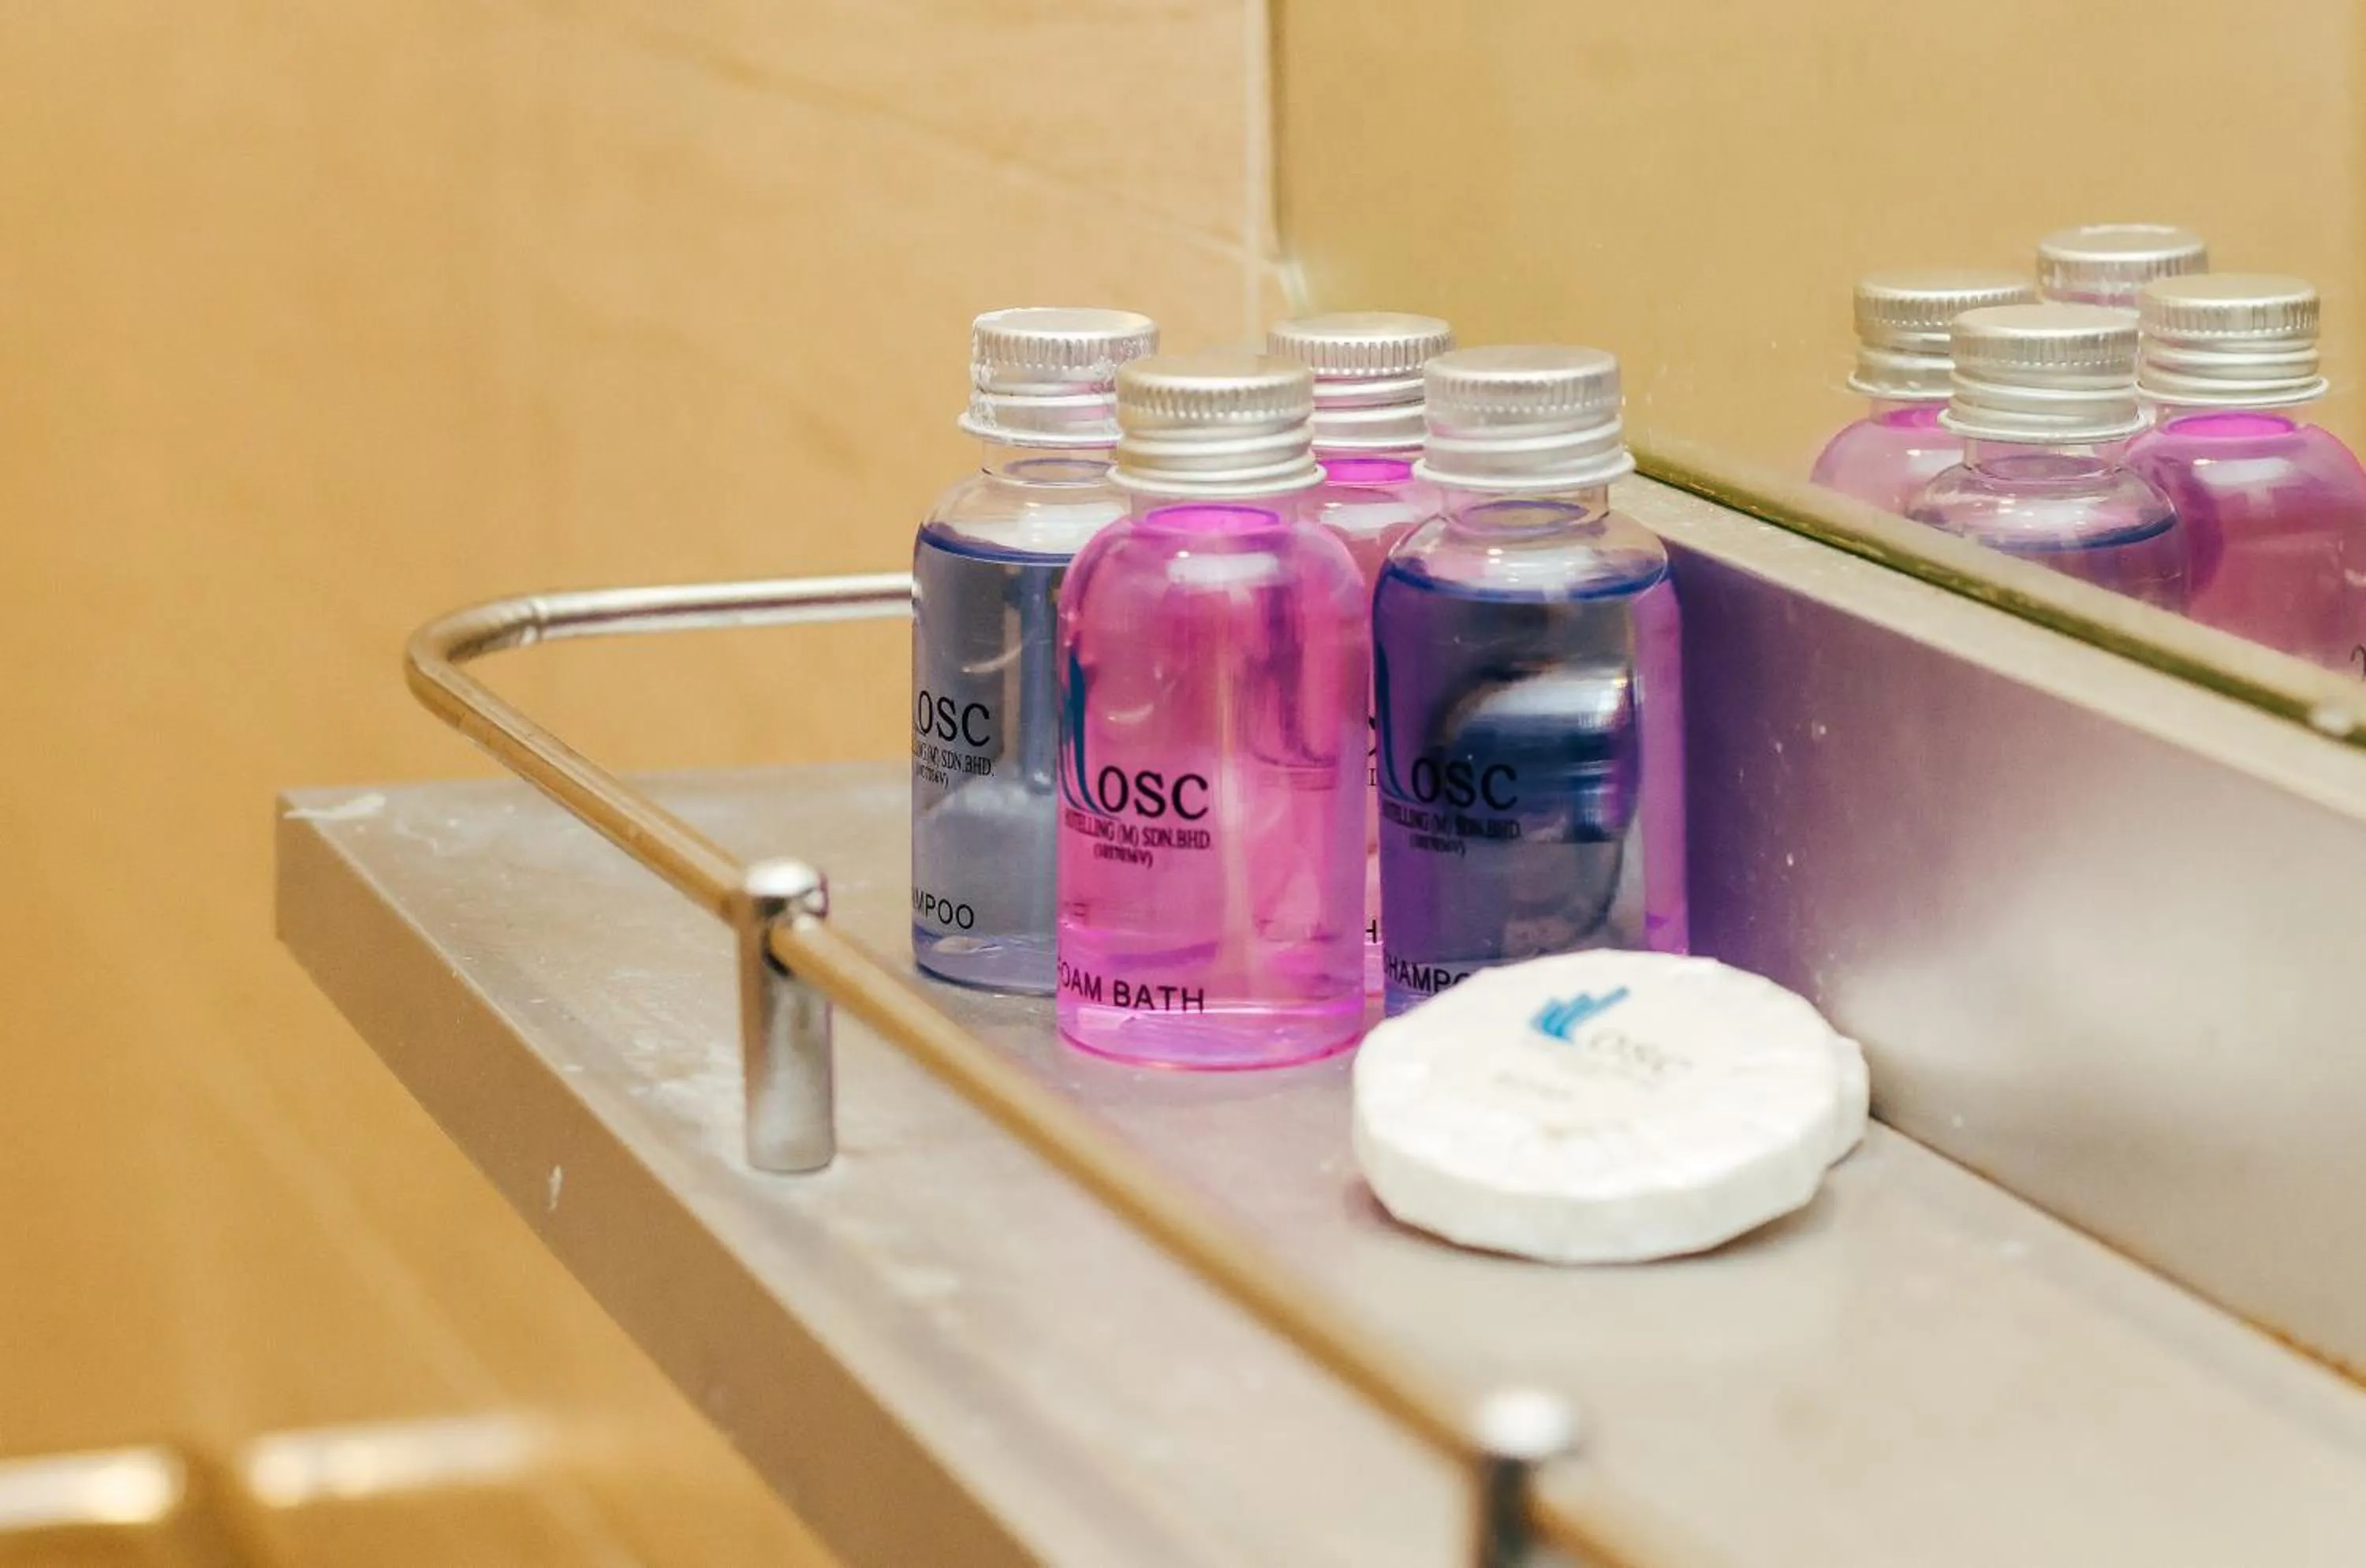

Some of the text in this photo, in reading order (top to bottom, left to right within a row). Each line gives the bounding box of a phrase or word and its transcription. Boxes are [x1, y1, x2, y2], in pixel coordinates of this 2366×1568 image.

[917, 690, 991, 747] OSC
[1098, 765, 1208, 820] OSC
[1412, 758, 1518, 811] OSC
[912, 887, 974, 929] MPOO
[1383, 950, 1470, 993] HAMP
[1114, 979, 1204, 1014] BATH
